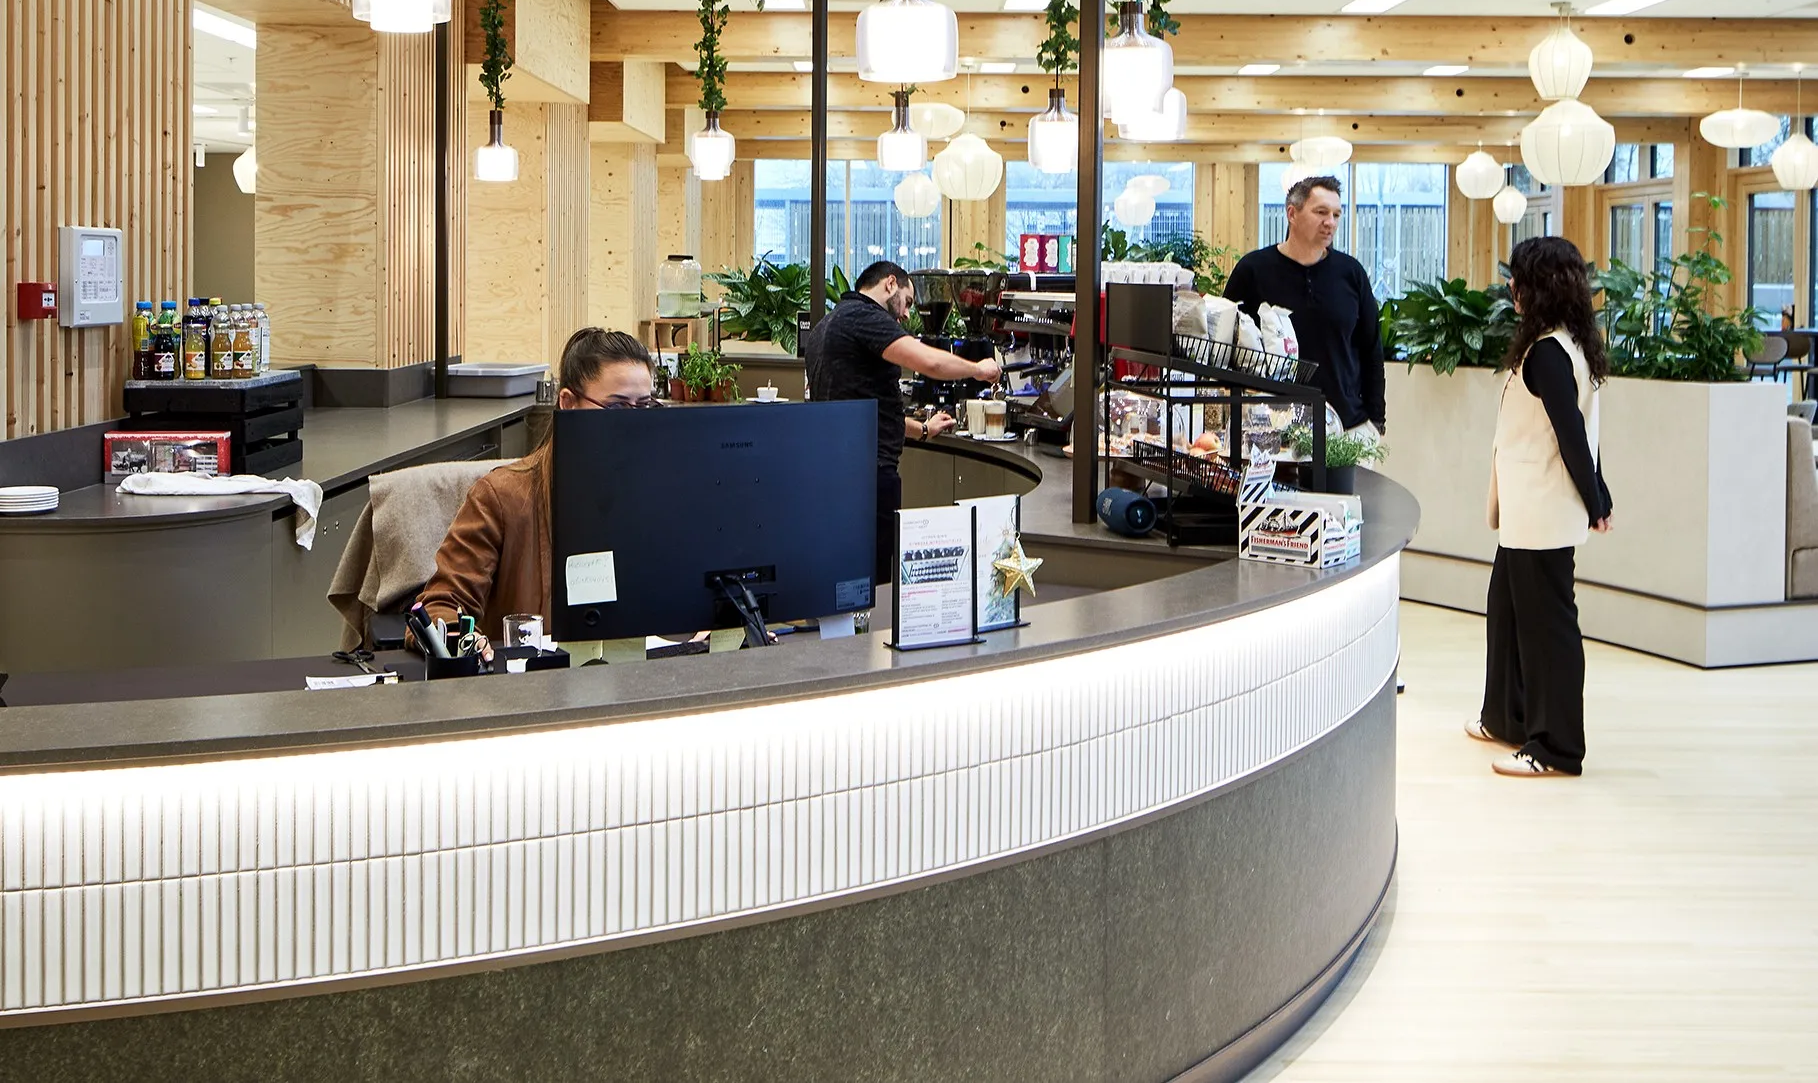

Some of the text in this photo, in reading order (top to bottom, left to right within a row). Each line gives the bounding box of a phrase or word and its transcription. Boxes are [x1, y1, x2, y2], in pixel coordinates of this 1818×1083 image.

[720, 441, 754, 449] SAMSUNG
[1251, 535, 1309, 549] FISHERMAN'S FRIEND
